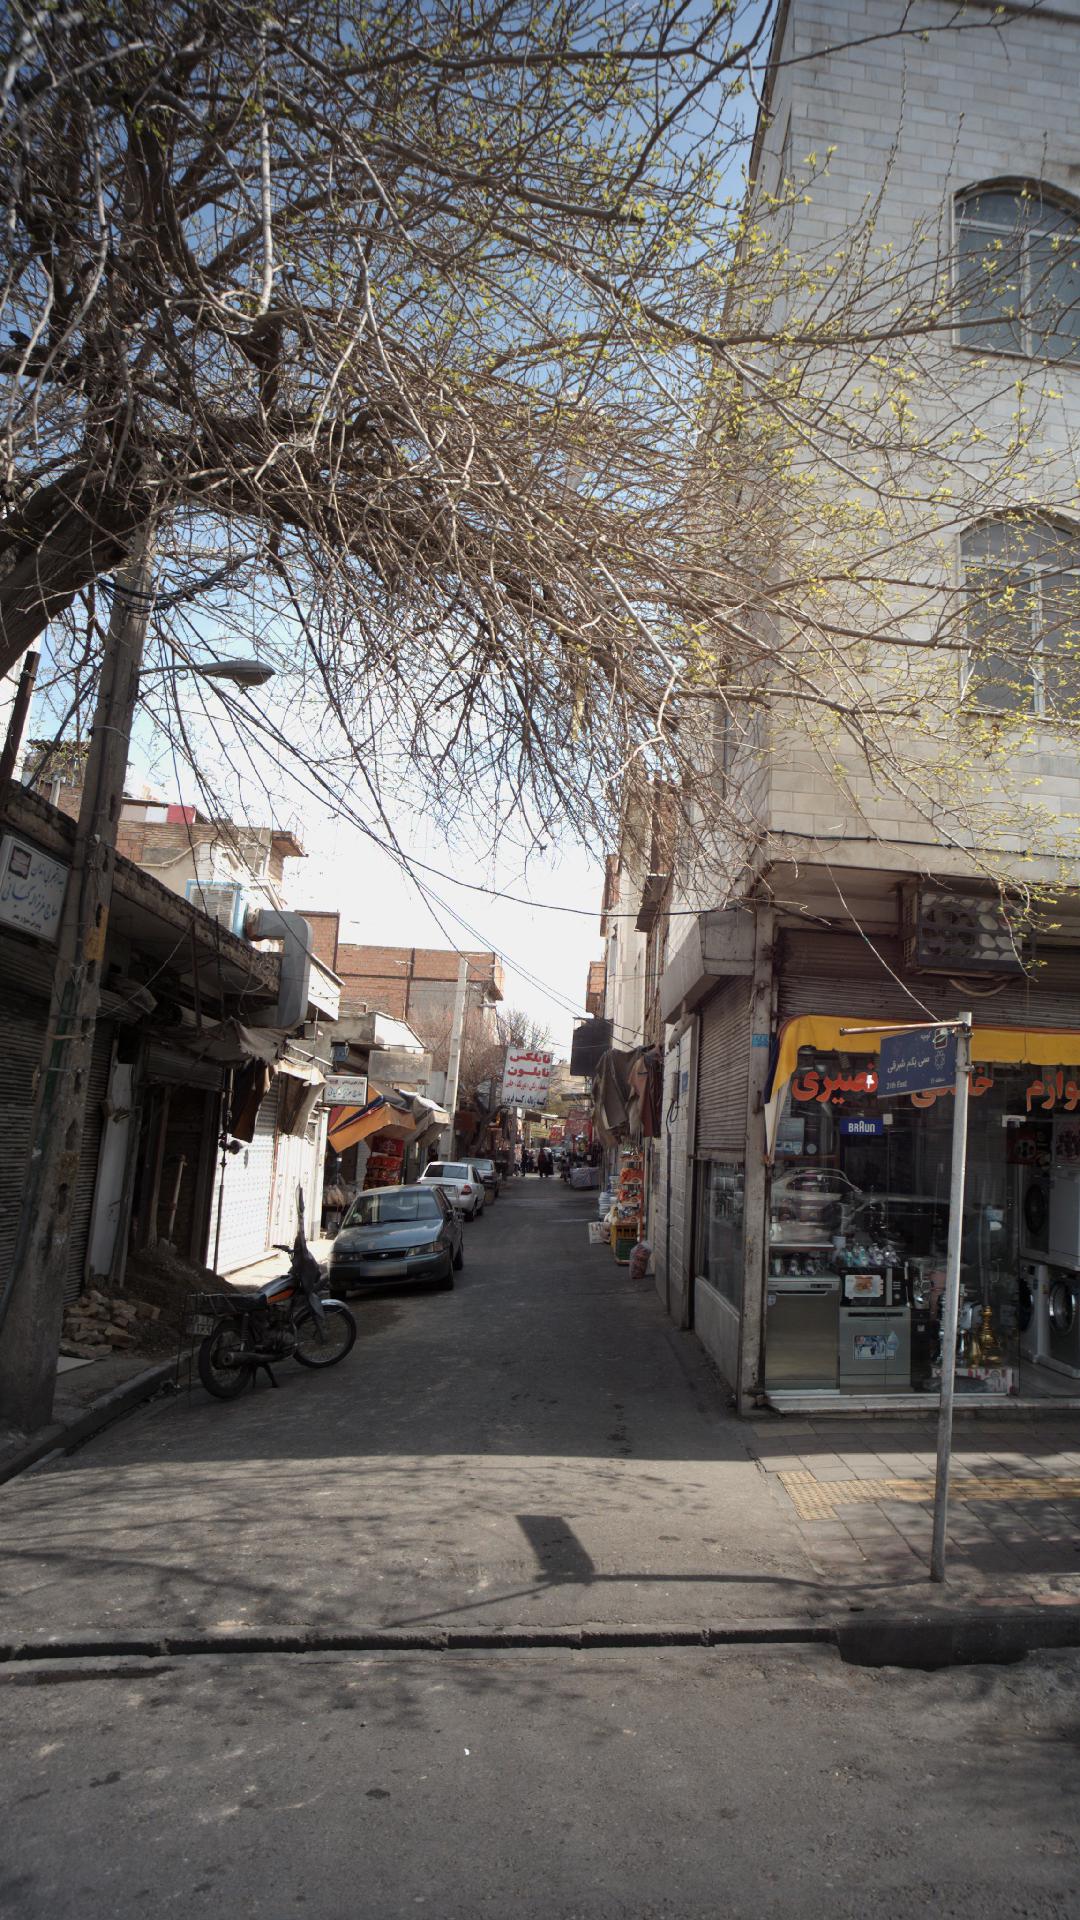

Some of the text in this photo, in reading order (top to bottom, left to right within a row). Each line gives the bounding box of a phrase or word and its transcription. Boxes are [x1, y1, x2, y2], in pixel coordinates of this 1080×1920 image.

[507, 1066, 550, 1079] نایلون
[887, 1058, 906, 1074] شرقی
[792, 1061, 879, 1104] نصیری
[1026, 1071, 1080, 1112] وازم
